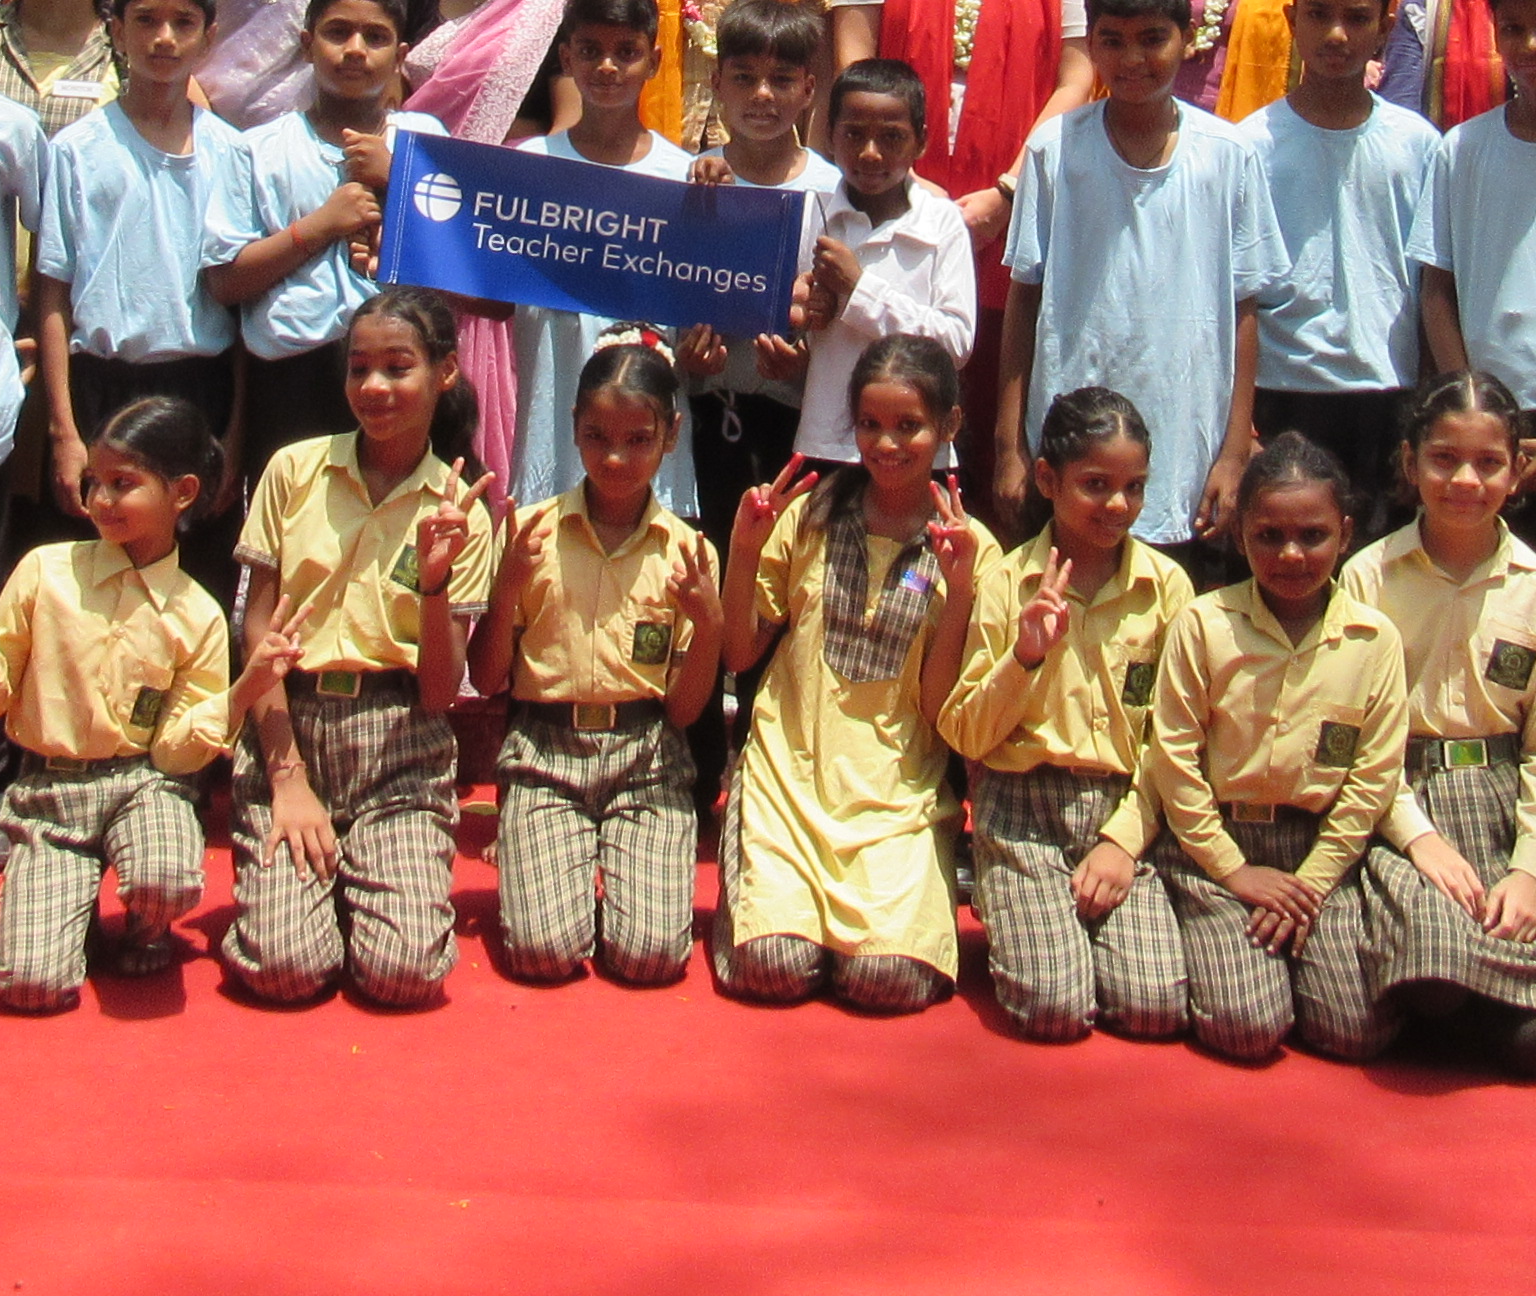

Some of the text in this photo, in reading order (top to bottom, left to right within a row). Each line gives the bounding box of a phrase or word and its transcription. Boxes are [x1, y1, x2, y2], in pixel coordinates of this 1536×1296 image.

[472, 191, 669, 245] FULBRIGHT
[471, 222, 768, 295] Teacher Exchanges
